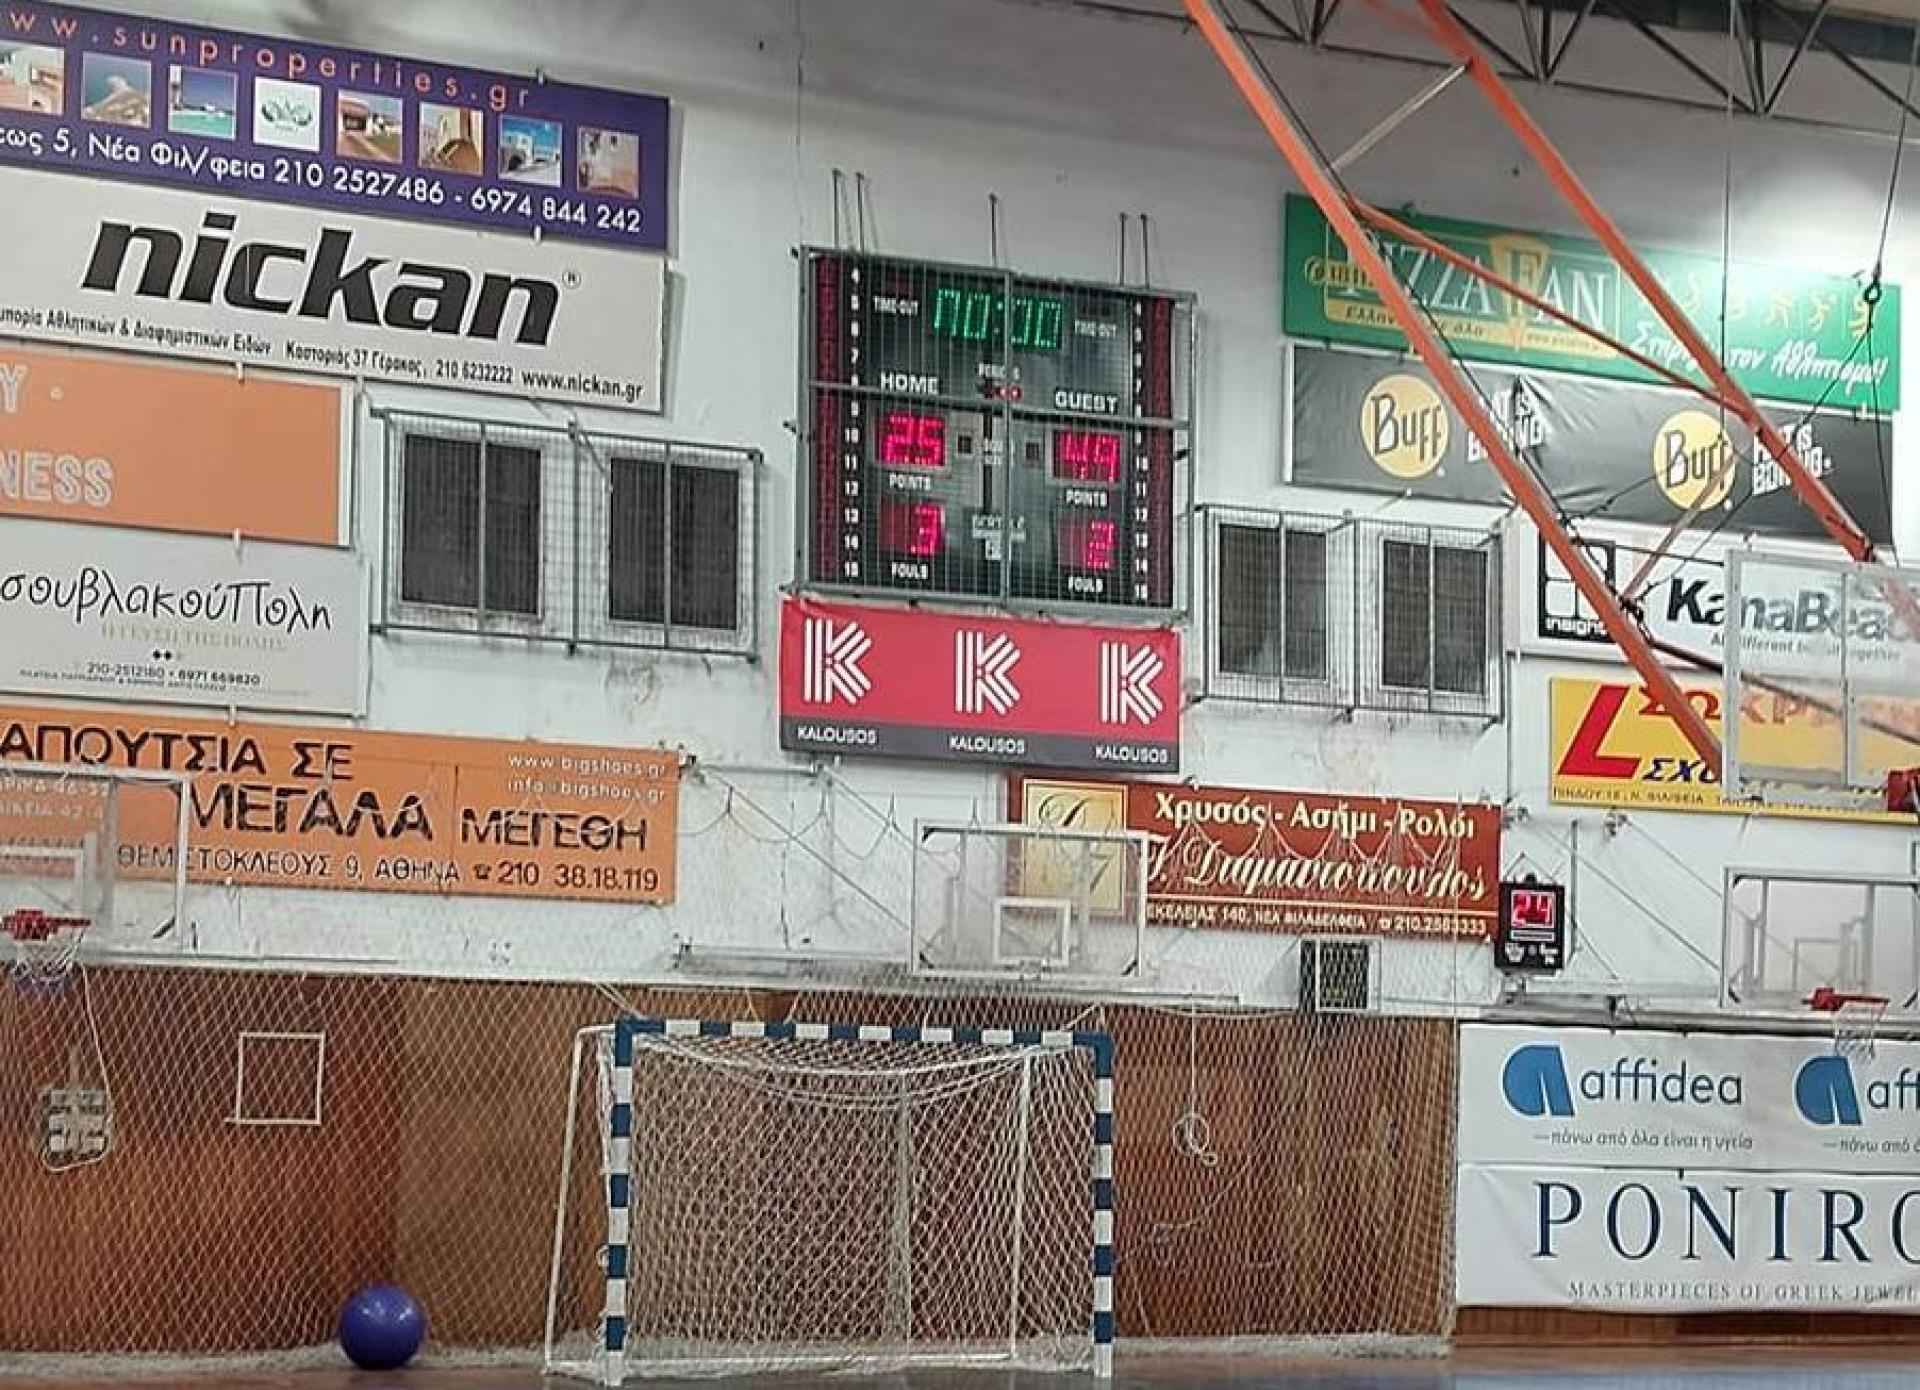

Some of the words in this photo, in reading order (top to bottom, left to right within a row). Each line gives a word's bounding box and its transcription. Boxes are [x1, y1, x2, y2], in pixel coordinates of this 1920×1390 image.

[89, 133, 139, 163] Νέα
[150, 142, 265, 181] Φιλ/φεια
[273, 159, 324, 187] 210
[332, 166, 444, 206] 2527486
[471, 187, 531, 217] 6974
[542, 198, 587, 224] 844
[597, 206, 641, 233] 242
[82, 213, 558, 345] nickan
[435, 358, 459, 378] 210
[521, 370, 643, 402] www.nickan.gr
[880, 372, 939, 395] HOME
[883, 410, 944, 468] 25
[1371, 392, 1442, 463] Buff
[910, 502, 944, 557] 3
[796, 724, 878, 745] KALOUSOS
[948, 735, 1026, 755] KALOUSOS
[1094, 745, 1169, 764] KALOUSOS
[291, 741, 354, 780] ΣΕ
[461, 807, 648, 851] ΜΕΓΕΘΗ
[1155, 792, 1267, 831] Χρυσός
[1290, 802, 1376, 840] Ασήμι
[1400, 808, 1474, 838] Ρολόι
[374, 857, 460, 883] ΑΘΗΝΑ
[499, 860, 540, 886] 210
[554, 863, 659, 893] 38.18.119
[1511, 891, 1553, 926] 24
[1580, 1057, 1742, 1105] affidea
[1568, 1281, 1730, 1300] MASTERPIECES
[1741, 1283, 1764, 1301] OF
[1774, 1283, 1844, 1301] GREEK
